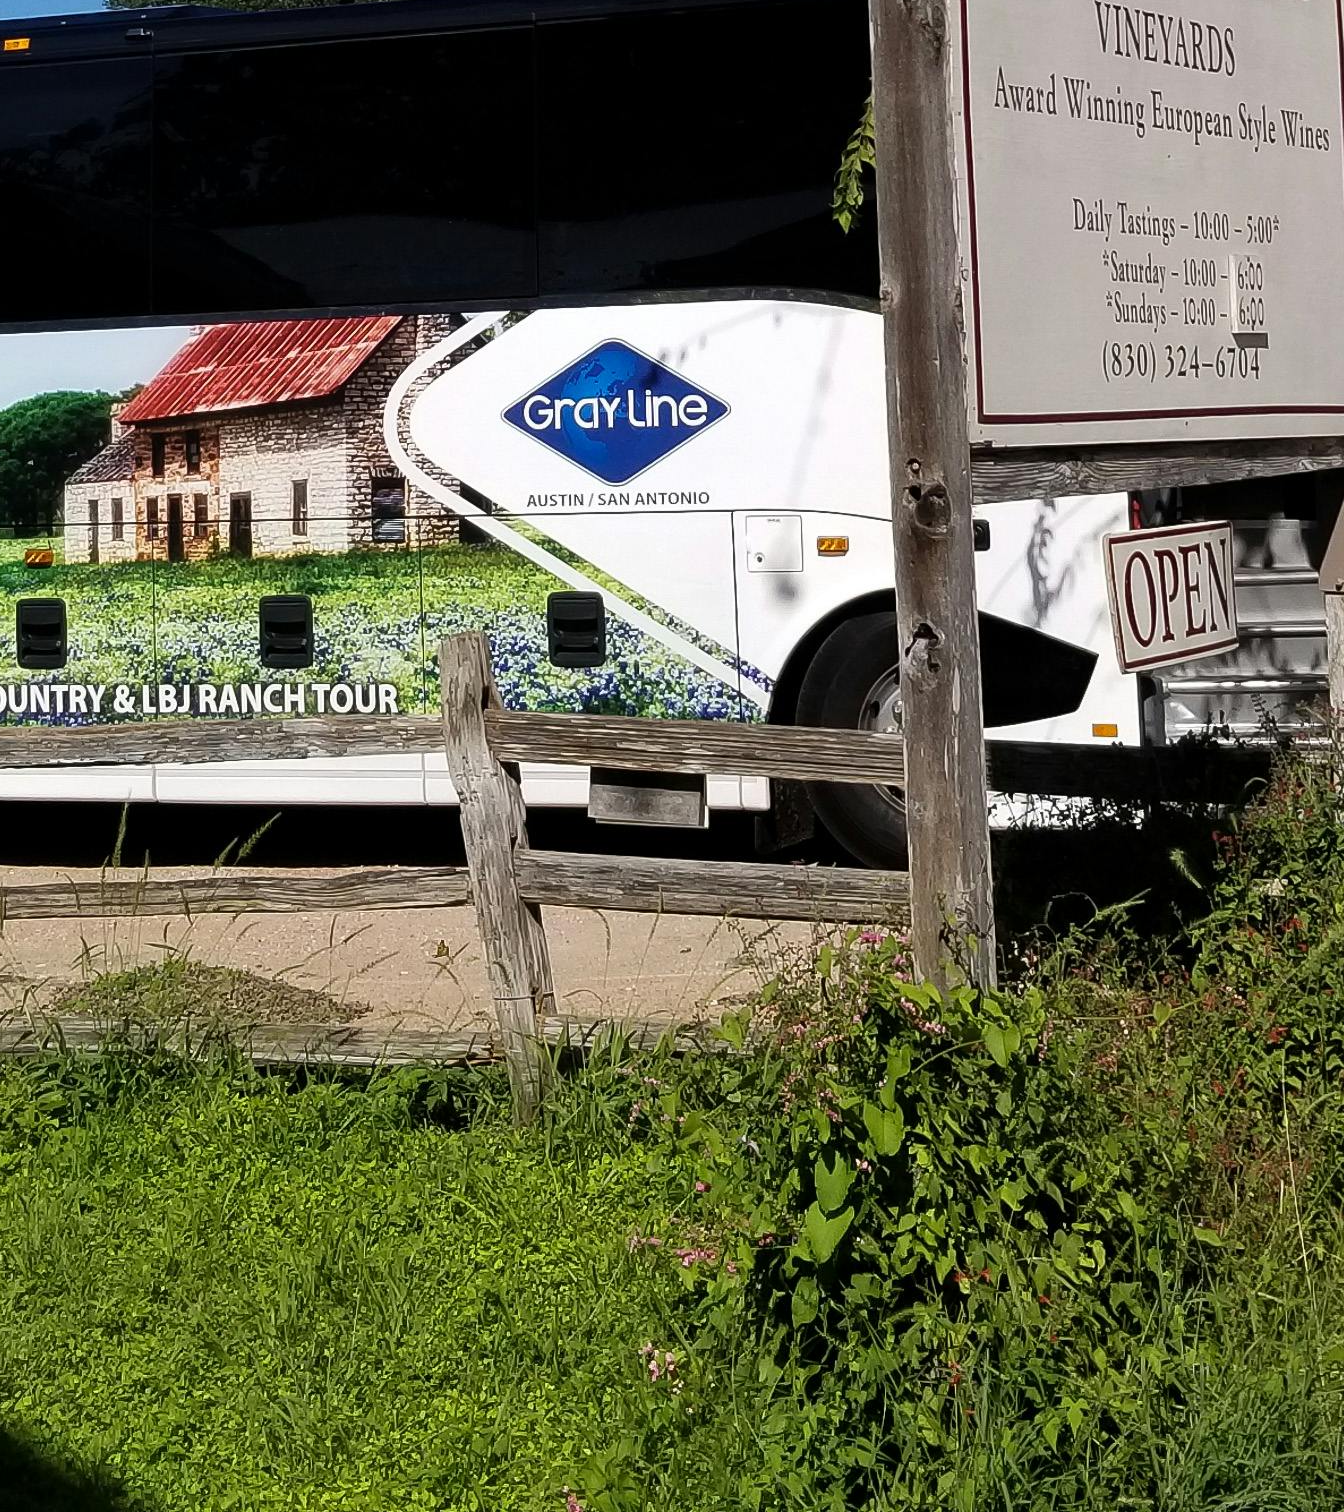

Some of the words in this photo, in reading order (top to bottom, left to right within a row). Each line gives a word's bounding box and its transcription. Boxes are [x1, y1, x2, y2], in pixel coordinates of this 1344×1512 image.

[1093, 0, 1236, 76] VINEYARDS
[994, 65, 1058, 116] Award
[1063, 76, 1145, 138] Winning
[1151, 90, 1233, 145] European
[1238, 102, 1276, 152] Style
[1280, 109, 1330, 151] Wines
[1073, 198, 1112, 242] Daily
[1117, 202, 1176, 246] Tastings
[1193, 211, 1229, 240] 10:00
[1183, 259, 1216, 287] 10:00
[1237, 259, 1263, 290] 6:00
[1183, 298, 1216, 326] 10:00
[1239, 296, 1265, 328] 6:00
[1102, 340, 1157, 383] (830)
[527, 494, 584, 508] AUSTIN
[598, 494, 630, 506] SAN
[634, 492, 710, 505] ANTONIO
[1124, 538, 1231, 648] OPEN
[113, 684, 135, 713] &
[142, 684, 190, 714] LBJ
[199, 684, 305, 714] RANCH
[311, 684, 398, 714] TOUR
